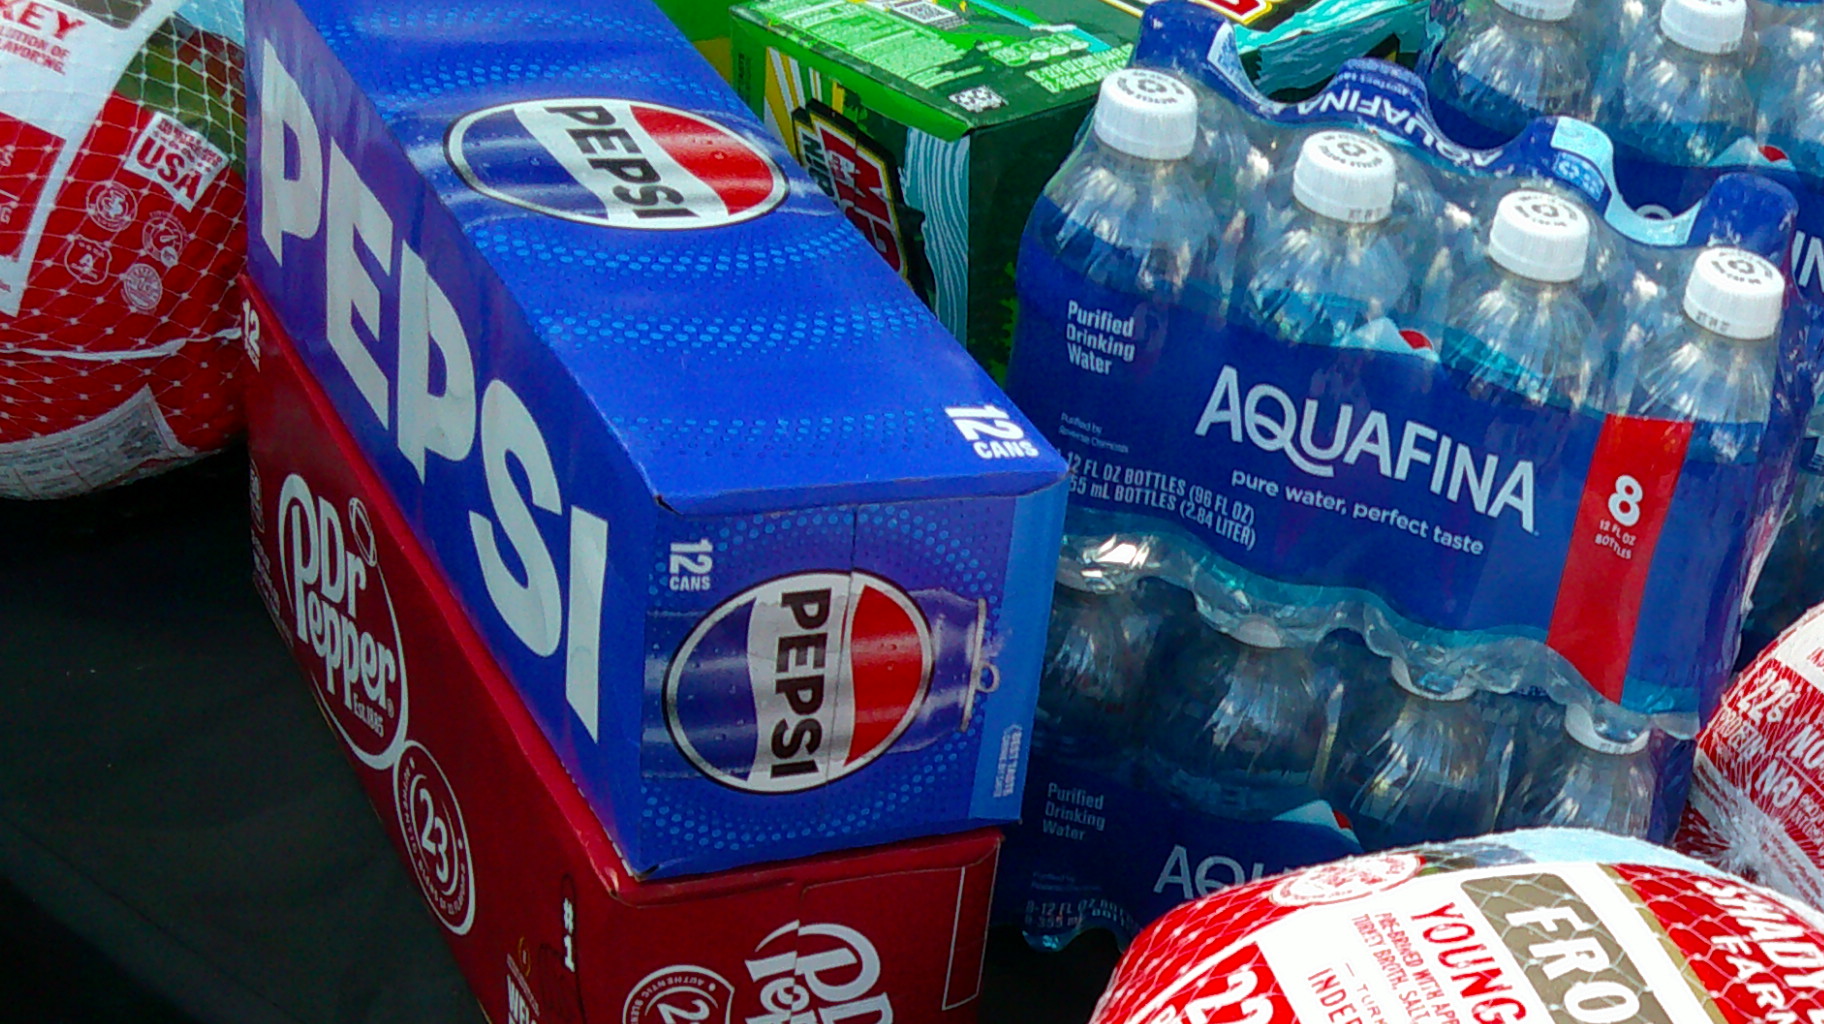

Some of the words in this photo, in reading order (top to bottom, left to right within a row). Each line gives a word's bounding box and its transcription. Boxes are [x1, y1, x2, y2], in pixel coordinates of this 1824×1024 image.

[1297, 90, 1503, 168] AQUAFINA
[543, 104, 702, 225] PEPSI
[1066, 323, 1137, 363] Drinking
[1067, 300, 1136, 338] Purified
[1067, 342, 1113, 376] Water
[261, 38, 609, 742] PEPSI
[944, 404, 1024, 442] 12
[973, 439, 1039, 461] CANS
[1194, 364, 1537, 534] AQUAFINA
[1083, 458, 1099, 479] FL
[1103, 463, 1123, 483] OZ
[1124, 467, 1186, 497] BOTTLES
[1214, 492, 1229, 516] FL
[1232, 503, 1255, 527] OZ)
[1090, 481, 1110, 500] mL
[1114, 484, 1177, 511] BOTTLES
[1216, 515, 1256, 551] LITER)
[1231, 467, 1279, 494] pure
[1284, 483, 1347, 516] water,
[1352, 501, 1428, 547] perfect
[1432, 522, 1485, 557] taste
[1607, 473, 1645, 527] 8
[316, 495, 367, 616] Dr
[669, 537, 713, 574] 12
[1594, 532, 1633, 560] BOTTLES
[1600, 519, 1611, 532] 12
[1611, 524, 1622, 540] FL
[1621, 531, 1637, 547] OZ
[277, 472, 396, 711] Pepper
[669, 574, 711, 592] CANS
[770, 587, 832, 779] PEPSI
[1048, 782, 1104, 810] Purified
[1754, 758, 1799, 809] NO
[418, 788, 450, 884] 23
[1042, 818, 1086, 841] Water
[1044, 801, 1106, 832] Drinking
